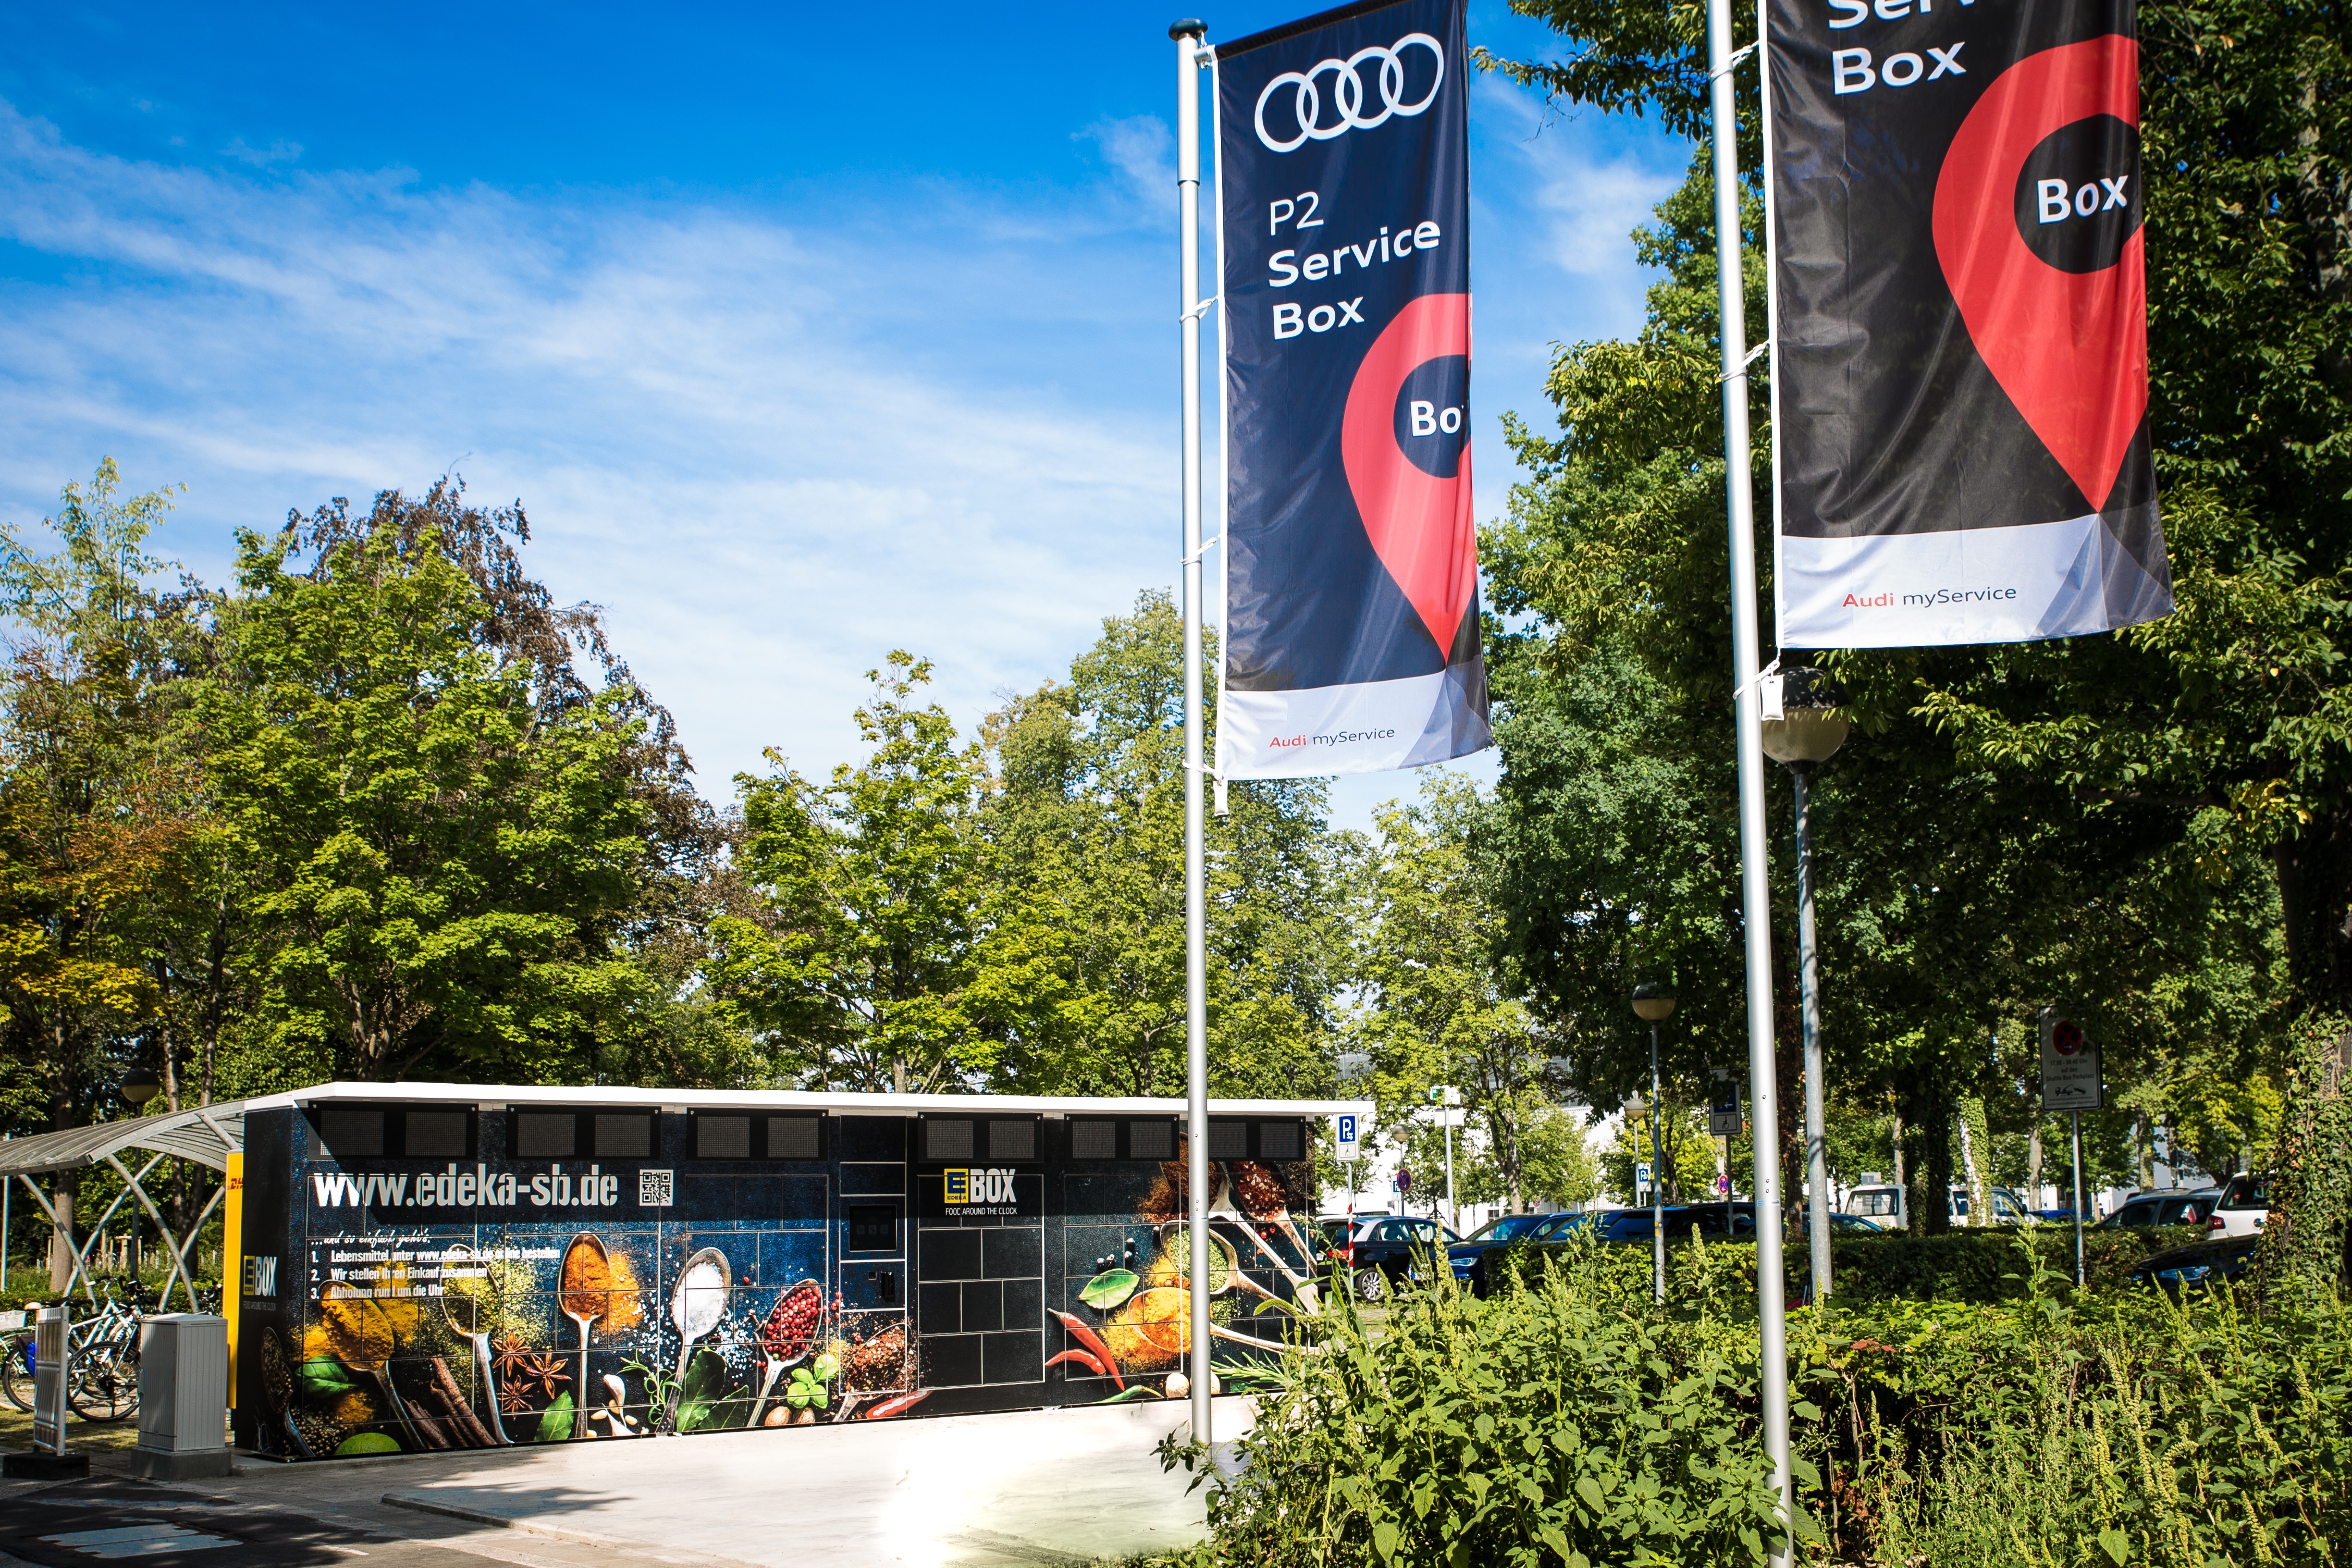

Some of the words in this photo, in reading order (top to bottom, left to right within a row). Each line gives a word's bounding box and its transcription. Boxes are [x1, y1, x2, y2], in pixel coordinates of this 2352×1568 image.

[1832, 41, 1967, 96] Box
[1270, 191, 1324, 236] P2
[2037, 175, 2129, 224] Box
[1268, 220, 1441, 288] Service
[1272, 296, 1365, 341] Box
[1410, 400, 1464, 437] Bo
[1842, 592, 1894, 608] Audi
[1902, 586, 2017, 608] myService
[1269, 734, 1307, 748] Audi
[1312, 727, 1395, 748] myService
[1342, 1119, 1352, 1139] P
[314, 1163, 618, 1207] www.edeka-sb.de
[970, 1169, 1017, 1203] BOX
[311, 1251, 319, 1263] 1.
[331, 1249, 390, 1263] Lebensmittel
[392, 1250, 415, 1261] unter
[521, 1246, 561, 1259] bestellen
[255, 1256, 278, 1296] BOX
[310, 1287, 320, 1300] 3.
[330, 1286, 372, 1299] Abholung
[397, 1287, 412, 1297] um
[413, 1284, 426, 1296] die
[428, 1284, 445, 1296] Uhr
[311, 1269, 320, 1281] 2.
[330, 1268, 347, 1281] Wir
[348, 1267, 380, 1280] stellen
[382, 1268, 406, 1279] Ihren
[407, 1266, 440, 1278] Einkauf
